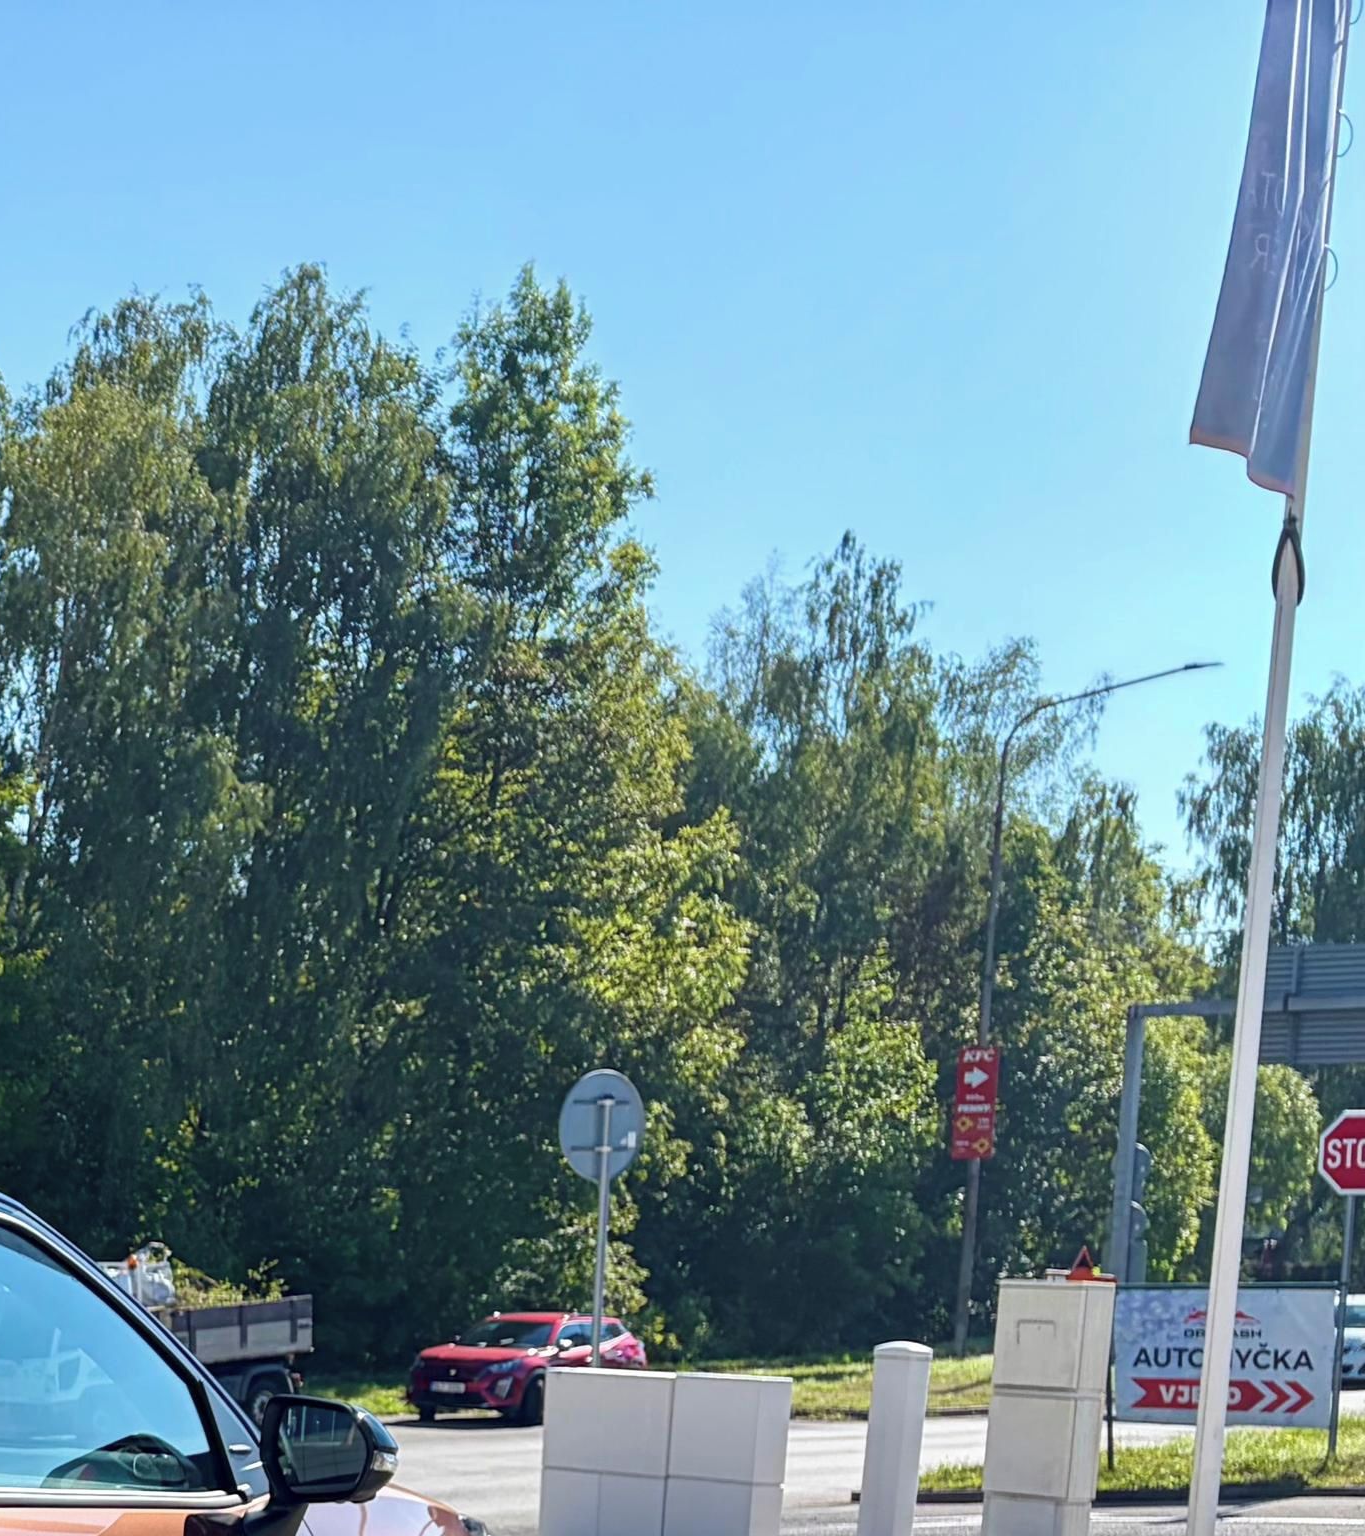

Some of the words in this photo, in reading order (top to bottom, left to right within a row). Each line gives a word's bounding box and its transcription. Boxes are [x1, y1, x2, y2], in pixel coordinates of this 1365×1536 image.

[963, 1048, 995, 1062] KFC
[1327, 1138, 1365, 1169] STO
[1133, 1343, 1315, 1371] AUTOYČKA
[1158, 1384, 1242, 1405] VJED
